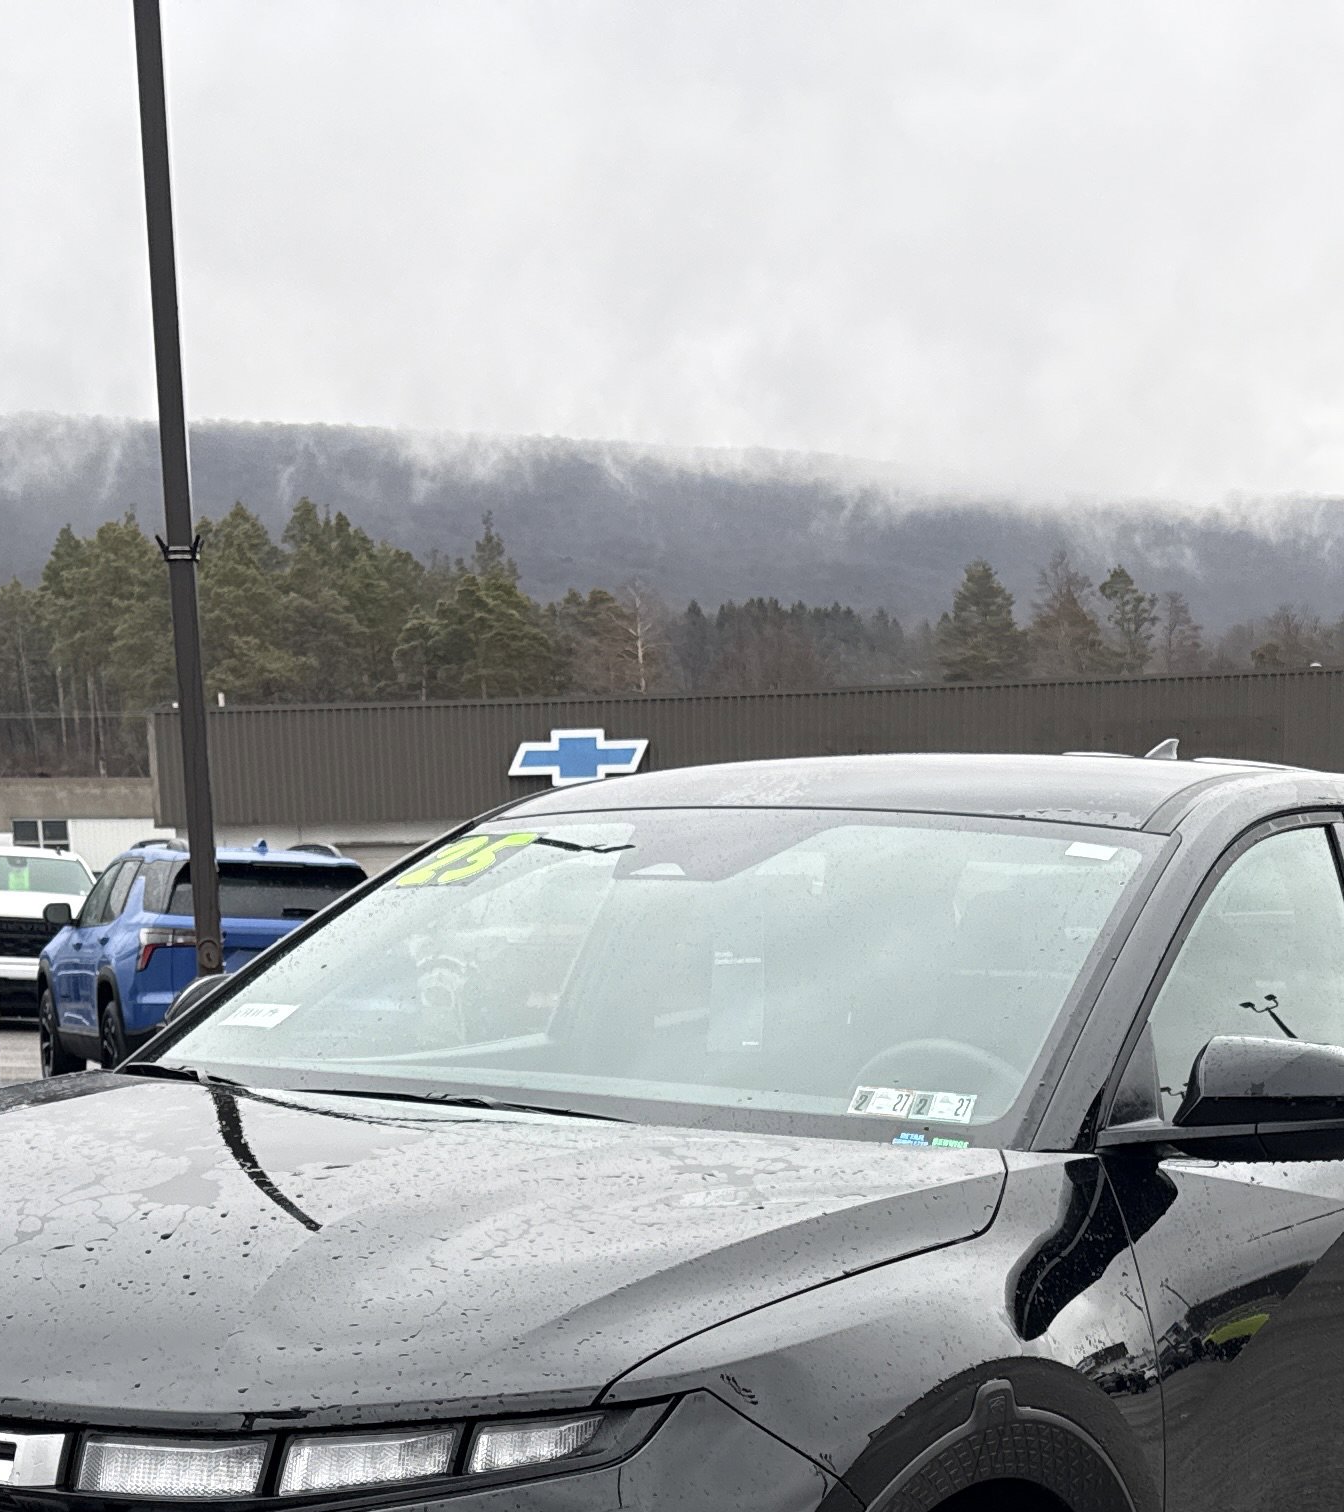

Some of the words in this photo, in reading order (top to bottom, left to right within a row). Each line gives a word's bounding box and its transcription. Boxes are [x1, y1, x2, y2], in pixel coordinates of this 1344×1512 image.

[395, 832, 540, 887] 25
[854, 1094, 869, 1112] 2
[892, 1093, 910, 1112] 27
[916, 1098, 929, 1115] 2
[953, 1097, 972, 1117] 27
